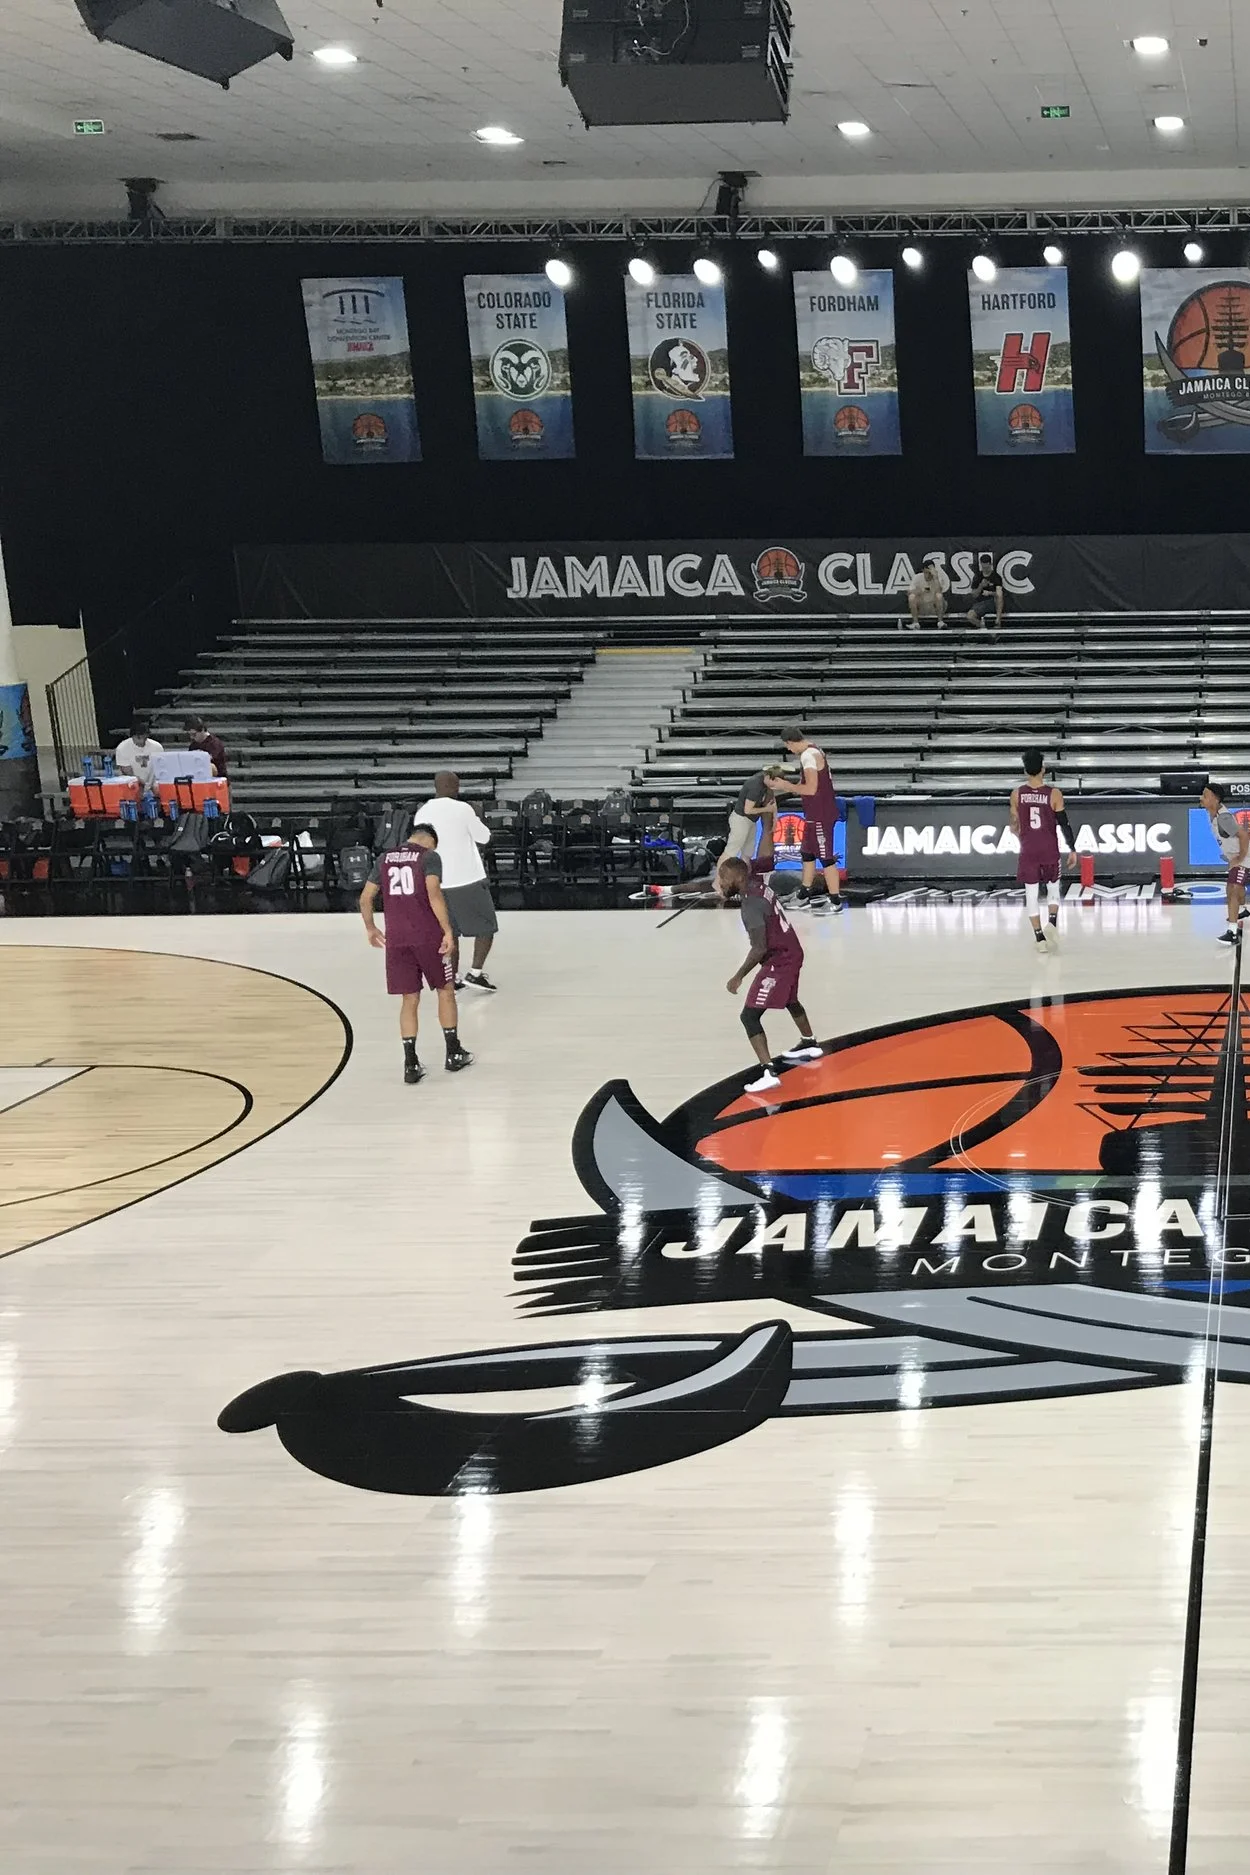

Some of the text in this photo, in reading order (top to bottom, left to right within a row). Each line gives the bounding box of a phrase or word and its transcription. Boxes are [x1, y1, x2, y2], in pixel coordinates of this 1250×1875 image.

[477, 291, 551, 310] COLORADO
[645, 291, 705, 310] FLORIDA
[809, 294, 879, 313] FORDHAM
[981, 291, 1056, 311] HARTFORD
[496, 313, 538, 330] STATE
[656, 313, 697, 330] STATE
[1179, 378, 1231, 395] JAMAICA
[507, 550, 1035, 599] JAMAICA CLASSC
[1030, 806, 1041, 829] 5
[862, 824, 1021, 855] JAMAICA
[387, 865, 415, 895] 20
[661, 1198, 1205, 1259] JAMAICA
